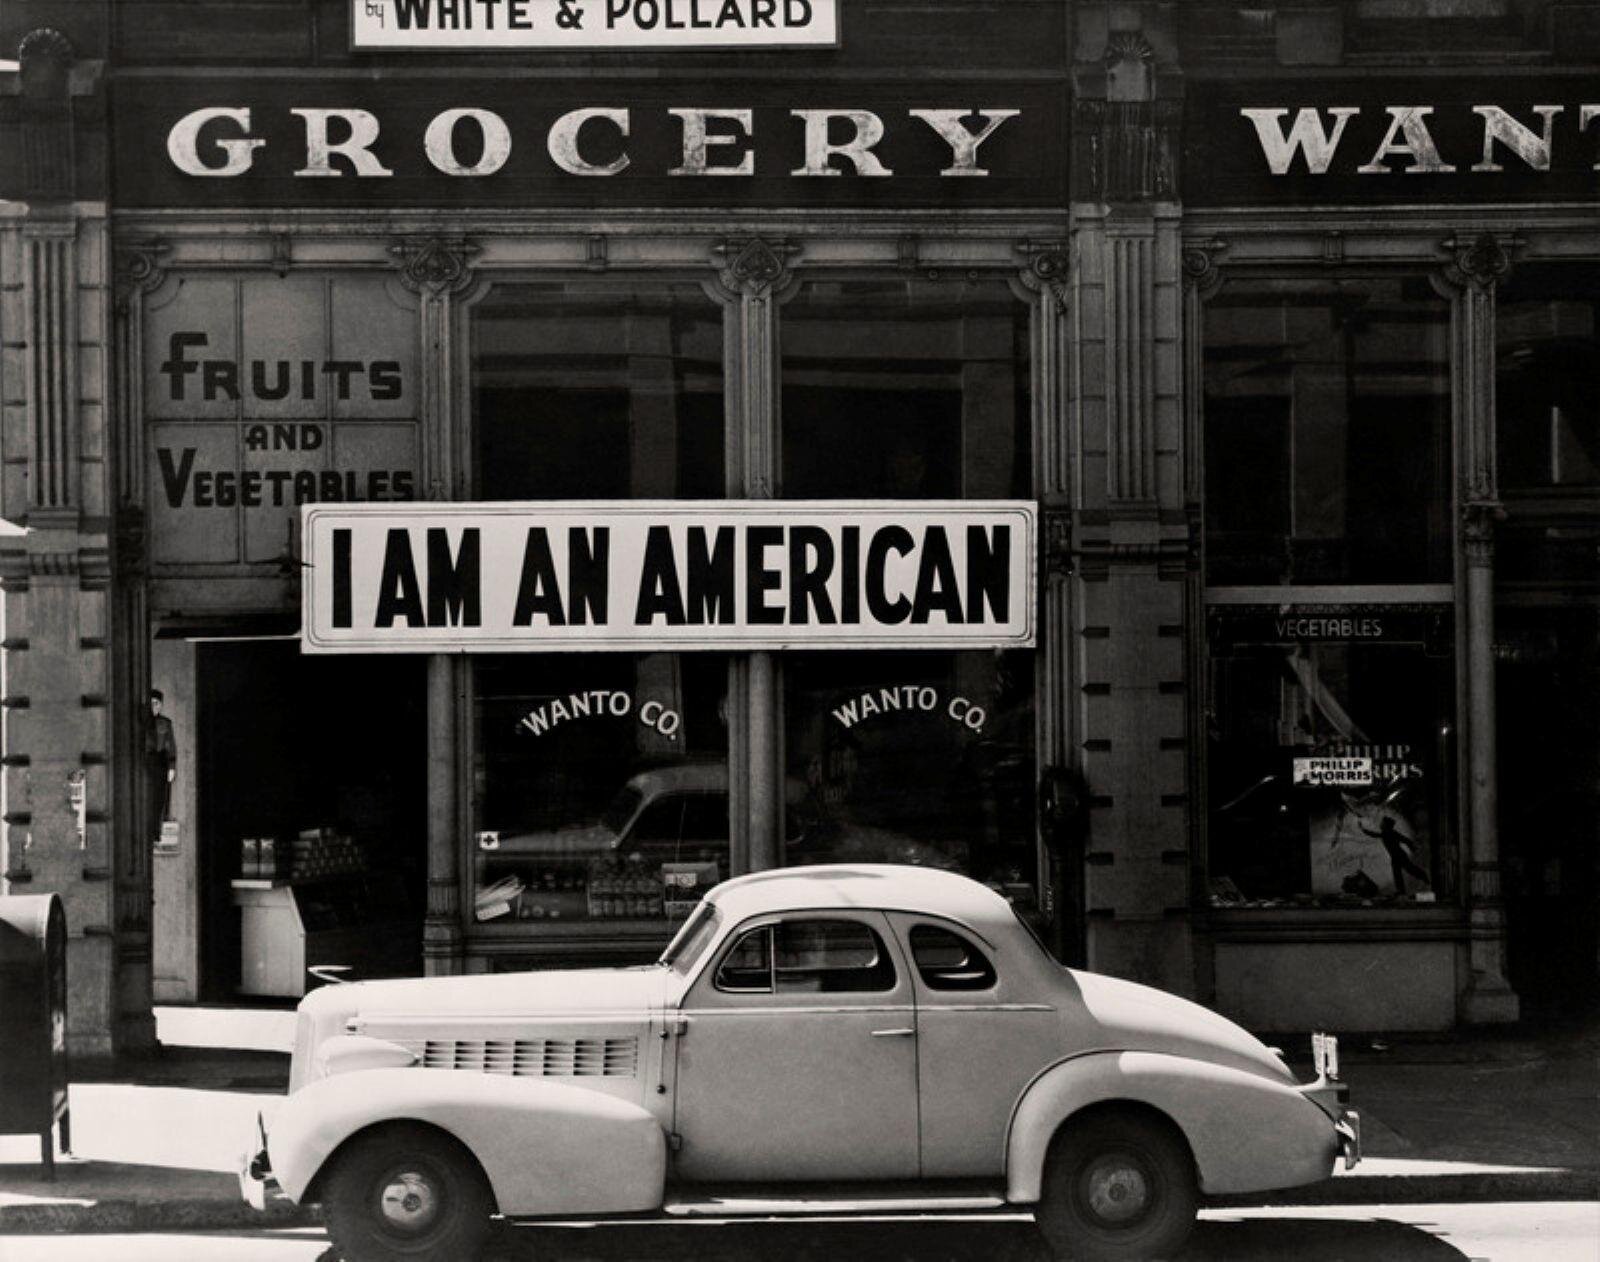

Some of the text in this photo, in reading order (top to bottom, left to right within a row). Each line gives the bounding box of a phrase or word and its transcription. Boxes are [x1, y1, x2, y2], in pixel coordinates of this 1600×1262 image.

[365, 0, 812, 30] by WHITE & POLLARD
[167, 106, 1021, 177] GROCERY
[1240, 104, 1600, 175] WAN
[245, 424, 323, 451] AND
[157, 447, 414, 508] VEGETABLES
[332, 525, 1010, 628] I AM AN AMERICAN
[1276, 618, 1383, 638] VEGETABLES
[521, 690, 681, 741] WANTO CO.
[831, 685, 987, 734] WANTO CO.
[1310, 760, 1363, 770] PHILIP
[1310, 771, 1372, 782] MORRIS
